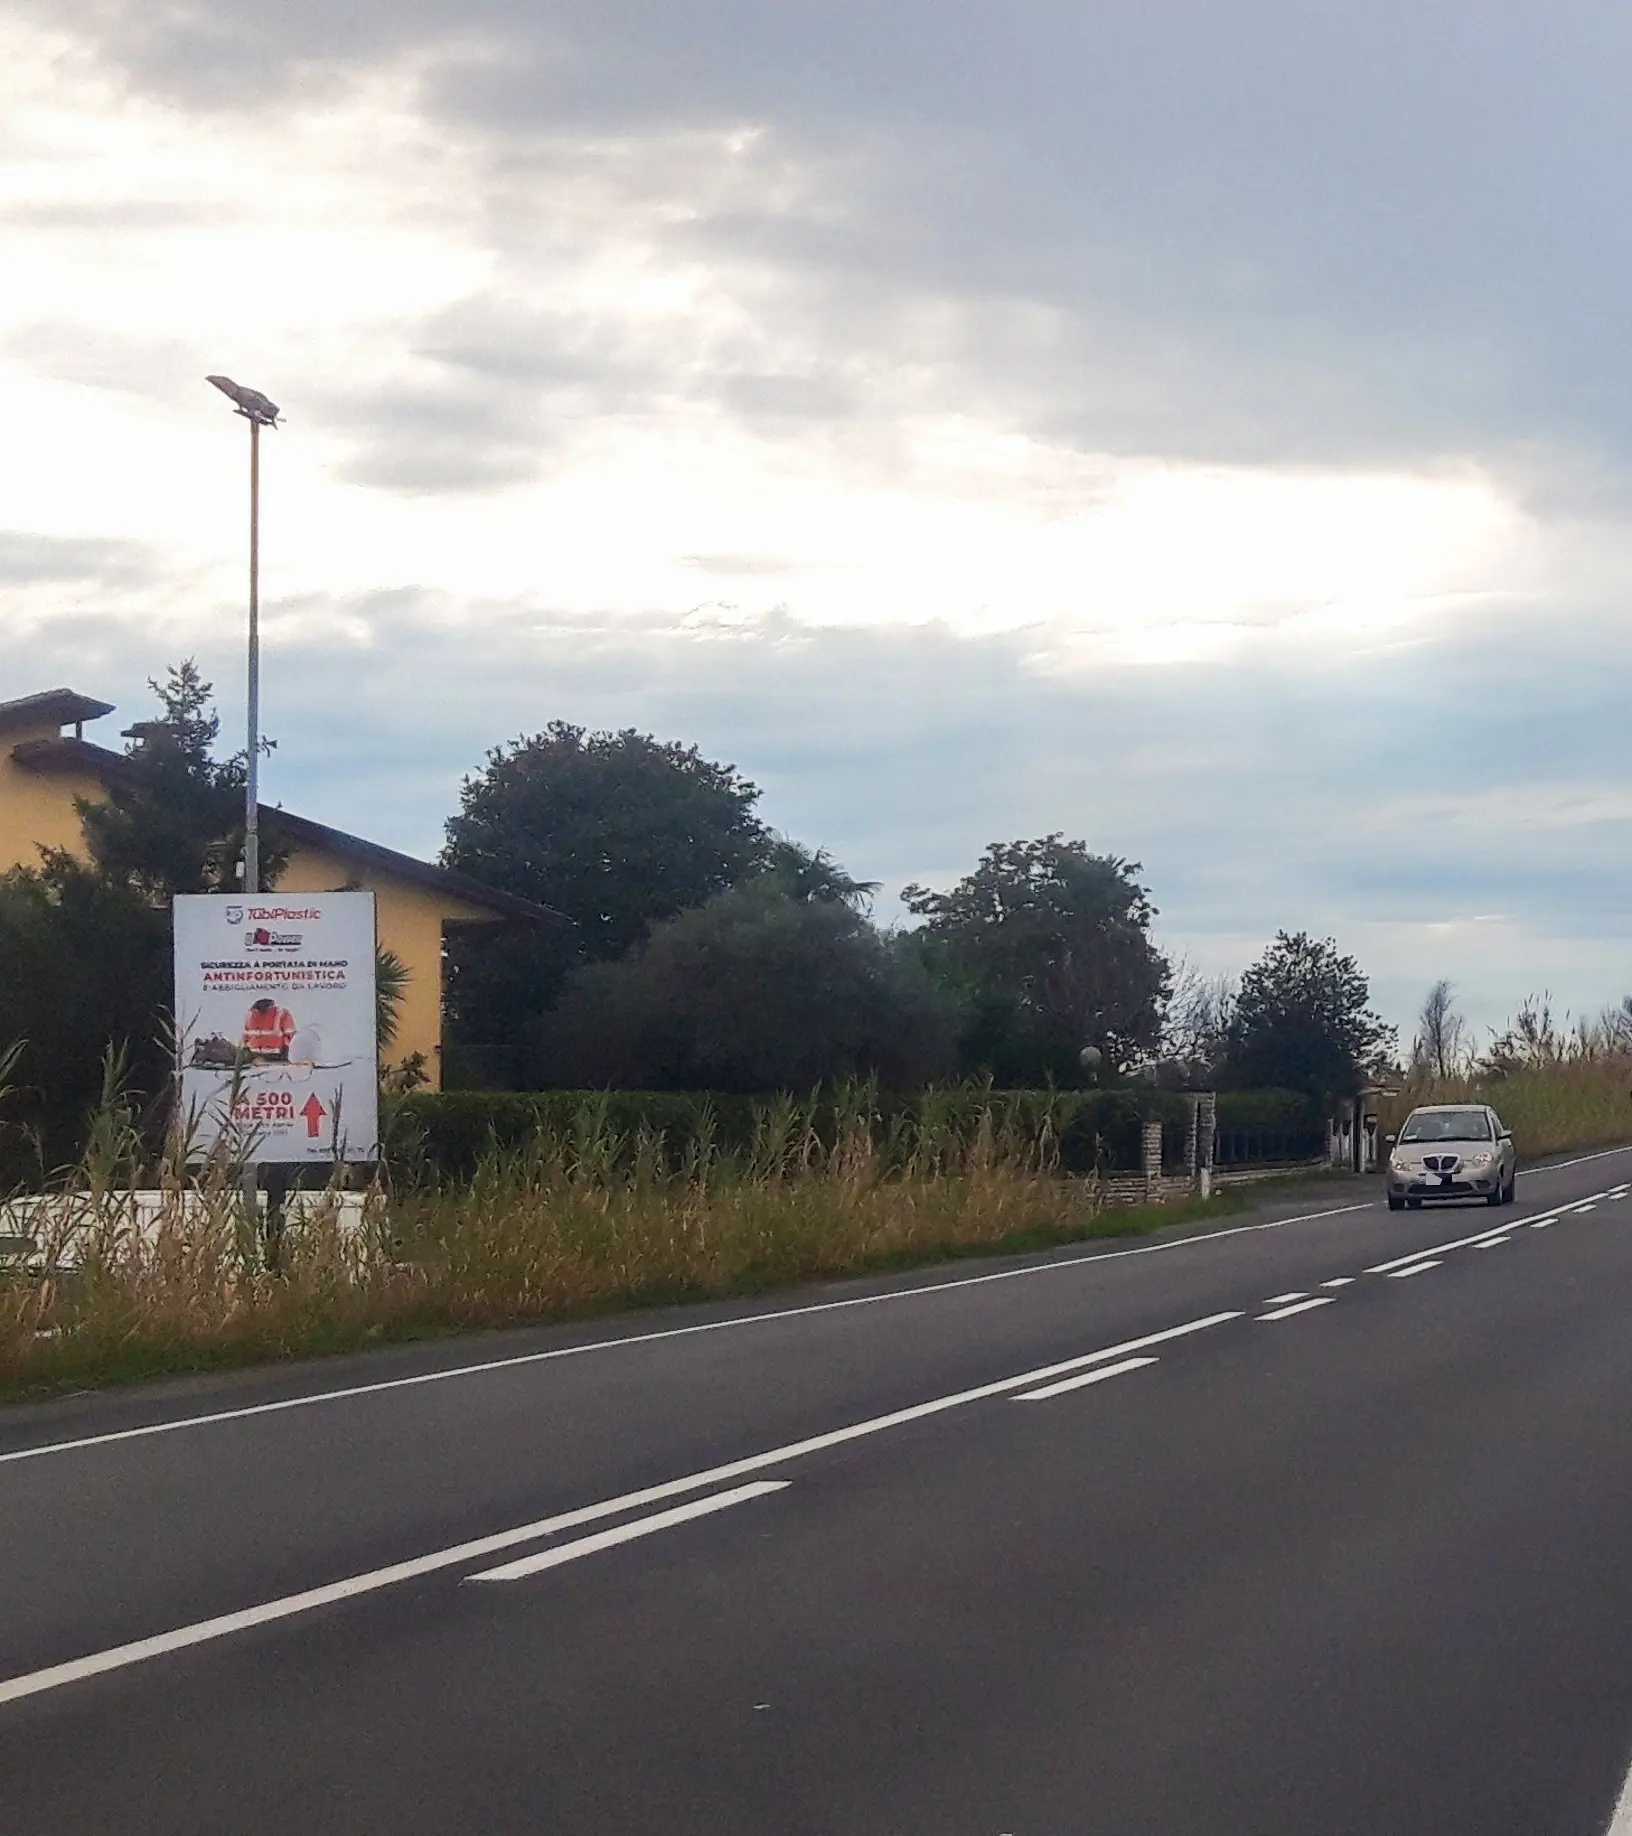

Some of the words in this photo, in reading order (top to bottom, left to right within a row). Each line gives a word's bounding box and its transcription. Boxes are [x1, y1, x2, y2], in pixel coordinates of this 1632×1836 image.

[204, 970, 346, 981] ANTINFORTUNISTICA
[256, 1092, 291, 1106] 500
[234, 1106, 294, 1119] METRI
